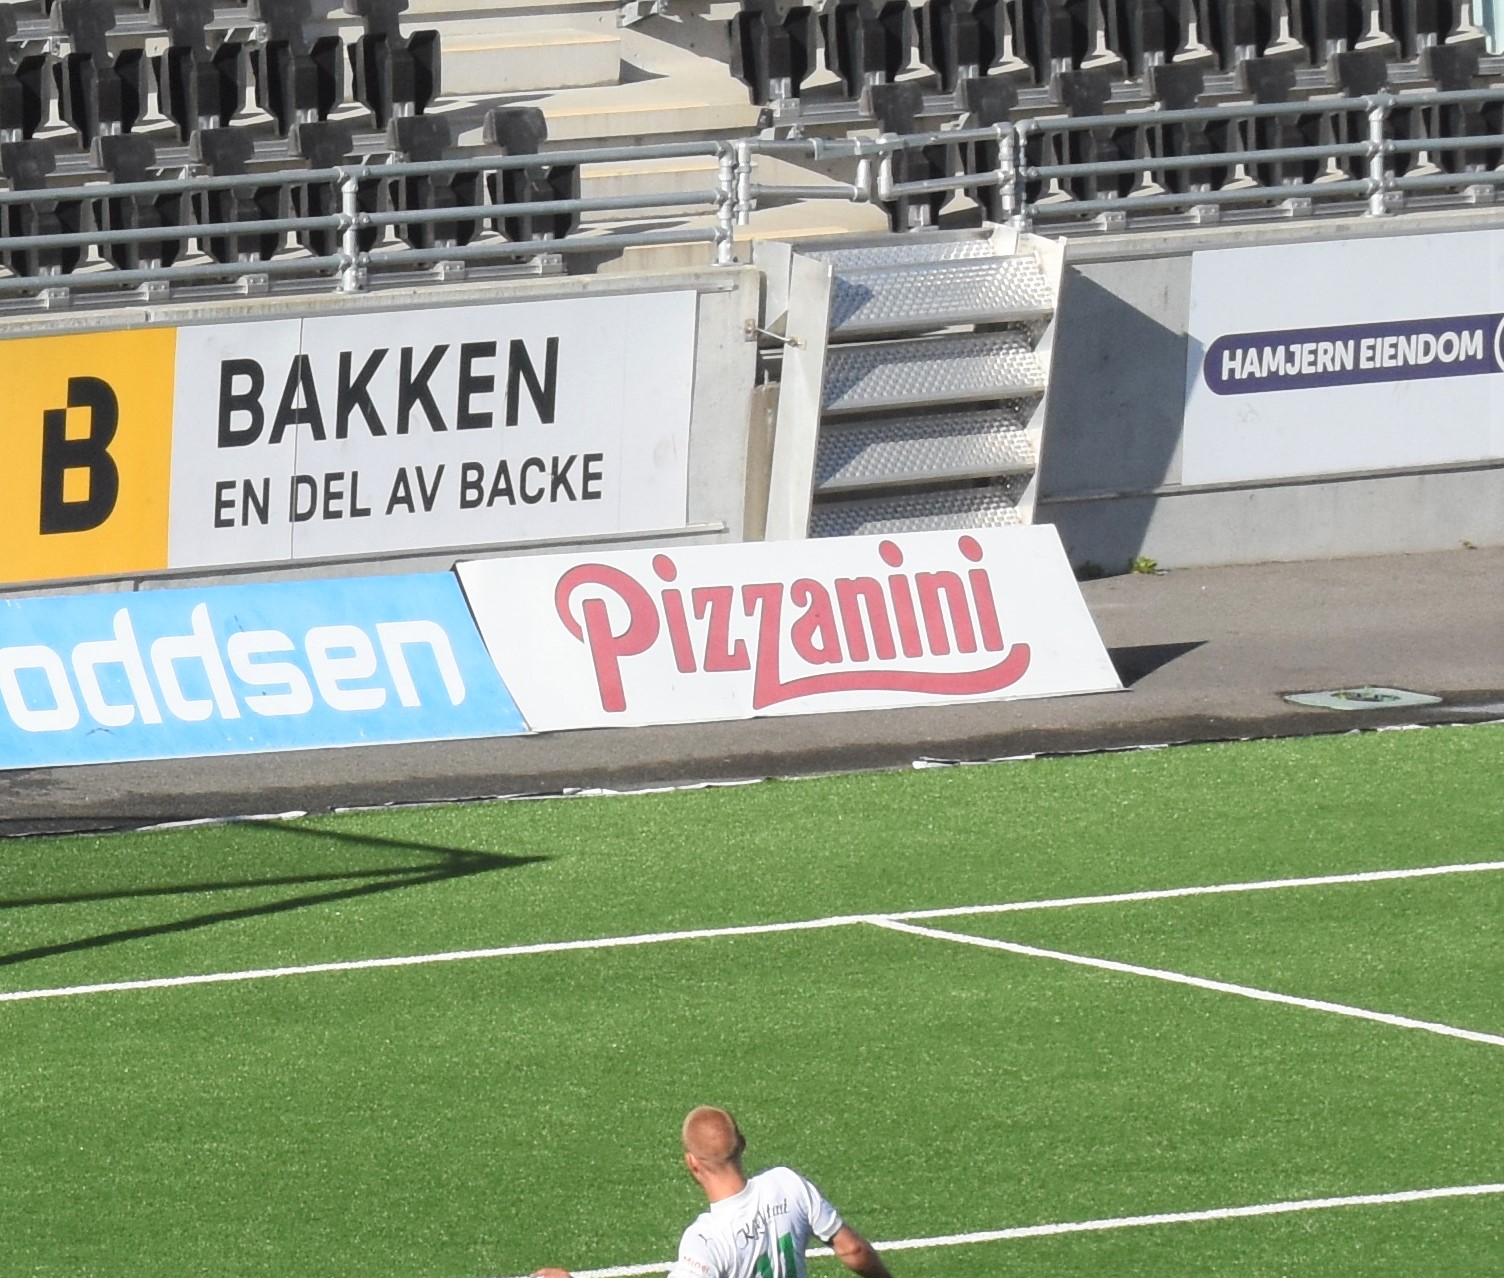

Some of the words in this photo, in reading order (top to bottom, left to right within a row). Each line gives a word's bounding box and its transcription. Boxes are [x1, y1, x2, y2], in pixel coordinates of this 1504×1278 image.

[216, 336, 561, 449] BAKKEN
[1221, 338, 1355, 381] HAMJERN
[1358, 329, 1485, 370] EIENDOM
[39, 376, 120, 536] B
[213, 476, 271, 530] EN
[288, 470, 372, 523] DEL
[385, 463, 445, 517] AV
[458, 452, 604, 511] BACKE
[554, 534, 1031, 713] Pizzanini
